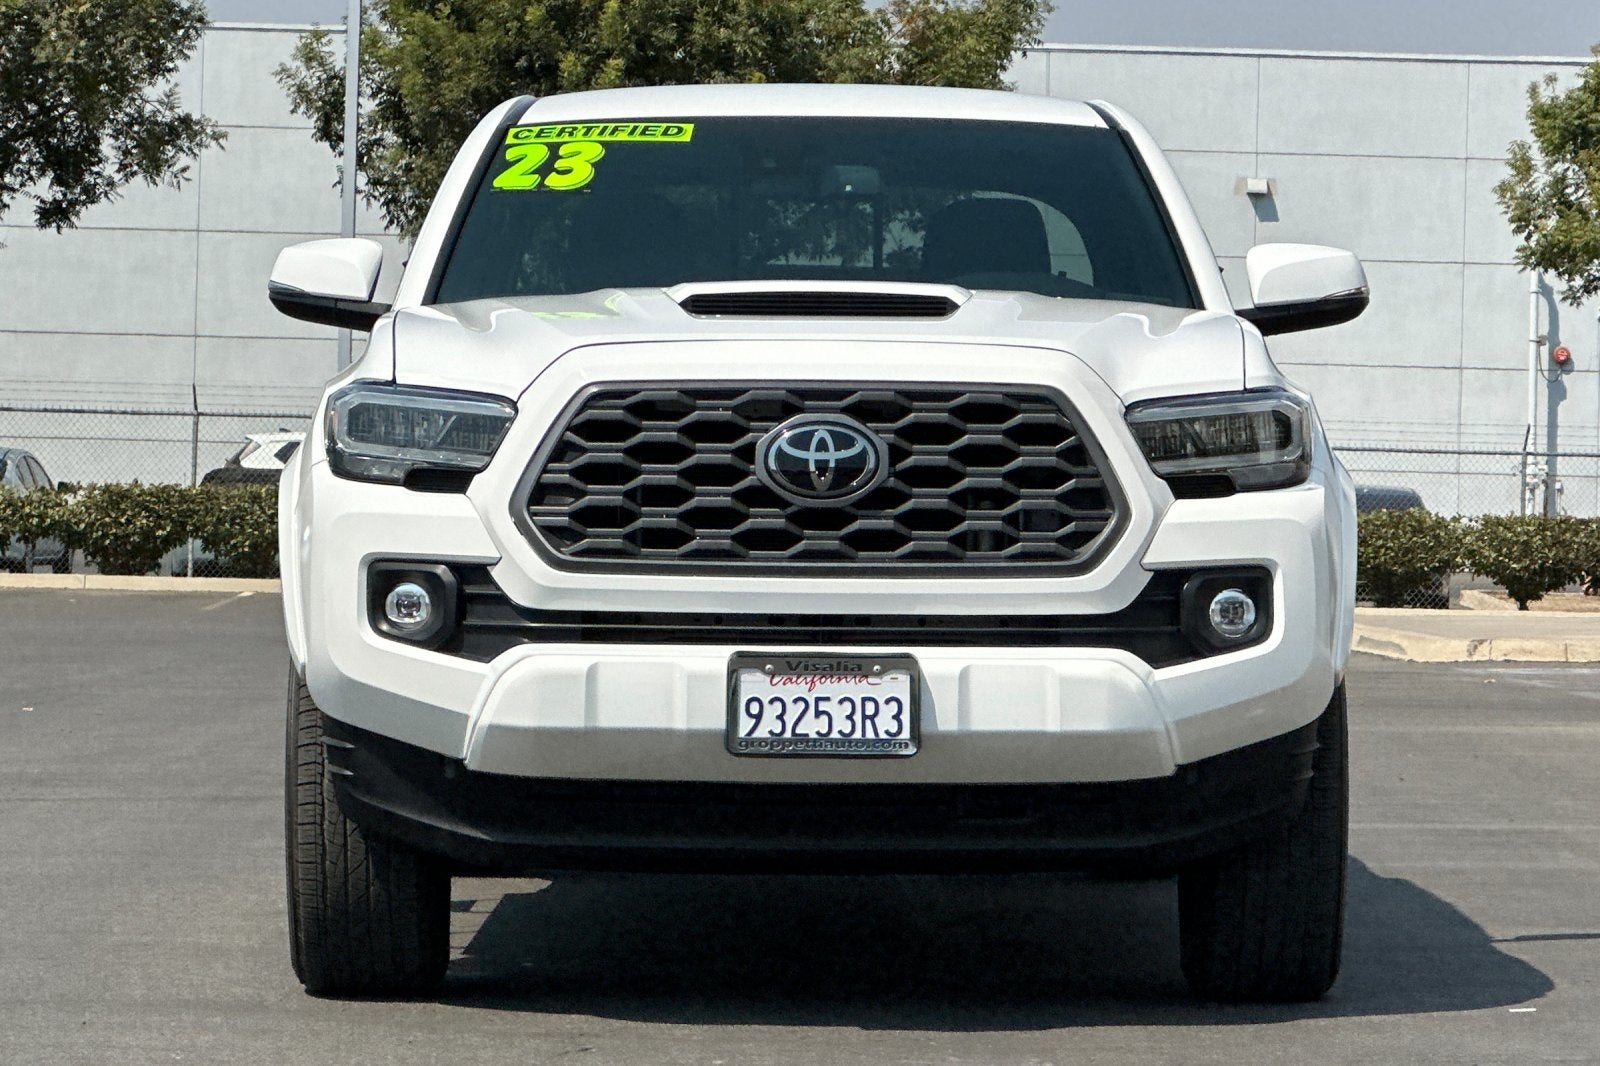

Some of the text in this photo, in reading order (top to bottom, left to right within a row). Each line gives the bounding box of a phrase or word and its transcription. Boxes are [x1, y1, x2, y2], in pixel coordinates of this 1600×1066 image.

[512, 125, 684, 140] CERTIFIED
[492, 141, 606, 190] 23
[785, 660, 863, 672] Visalia
[769, 673, 881, 692] California
[744, 696, 904, 738] 93253R3
